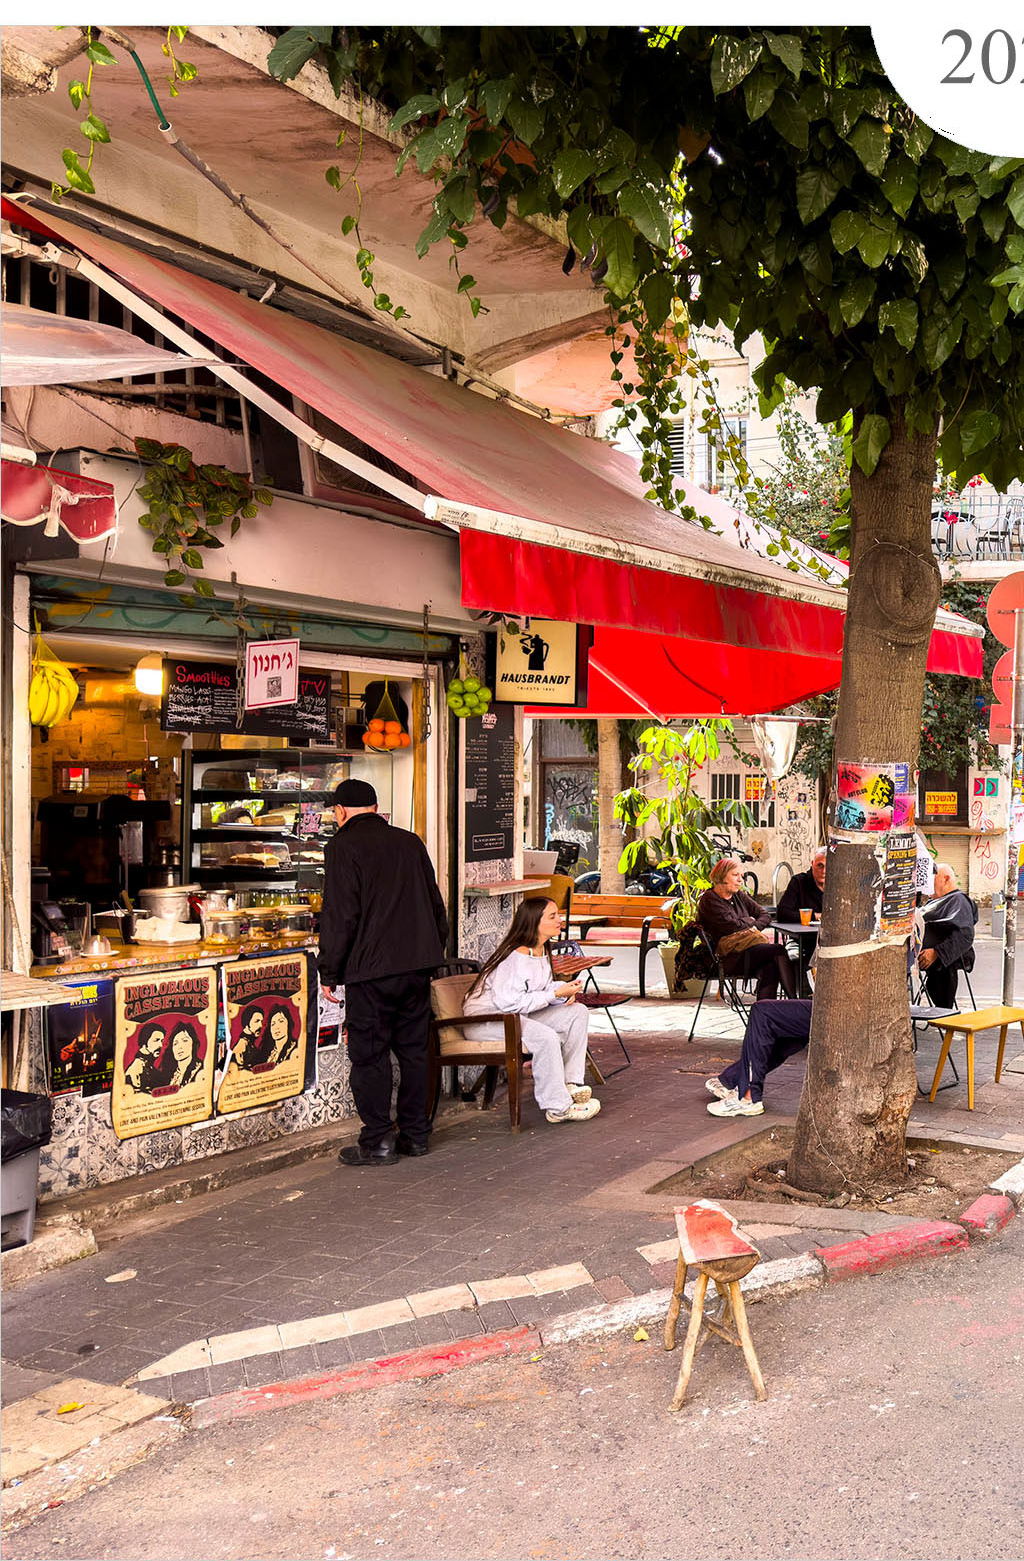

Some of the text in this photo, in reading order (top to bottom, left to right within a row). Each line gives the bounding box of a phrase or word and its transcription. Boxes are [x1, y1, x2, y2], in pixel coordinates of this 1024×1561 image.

[500, 673, 571, 685] HAUSBRANDT
[926, 793, 956, 802] להשכרה
[227, 962, 301, 986] INGLORIOUS
[123, 976, 210, 1004] INGLORIOUS
[227, 977, 301, 1002] CASSETTES
[123, 992, 210, 1020] CASSETTES
